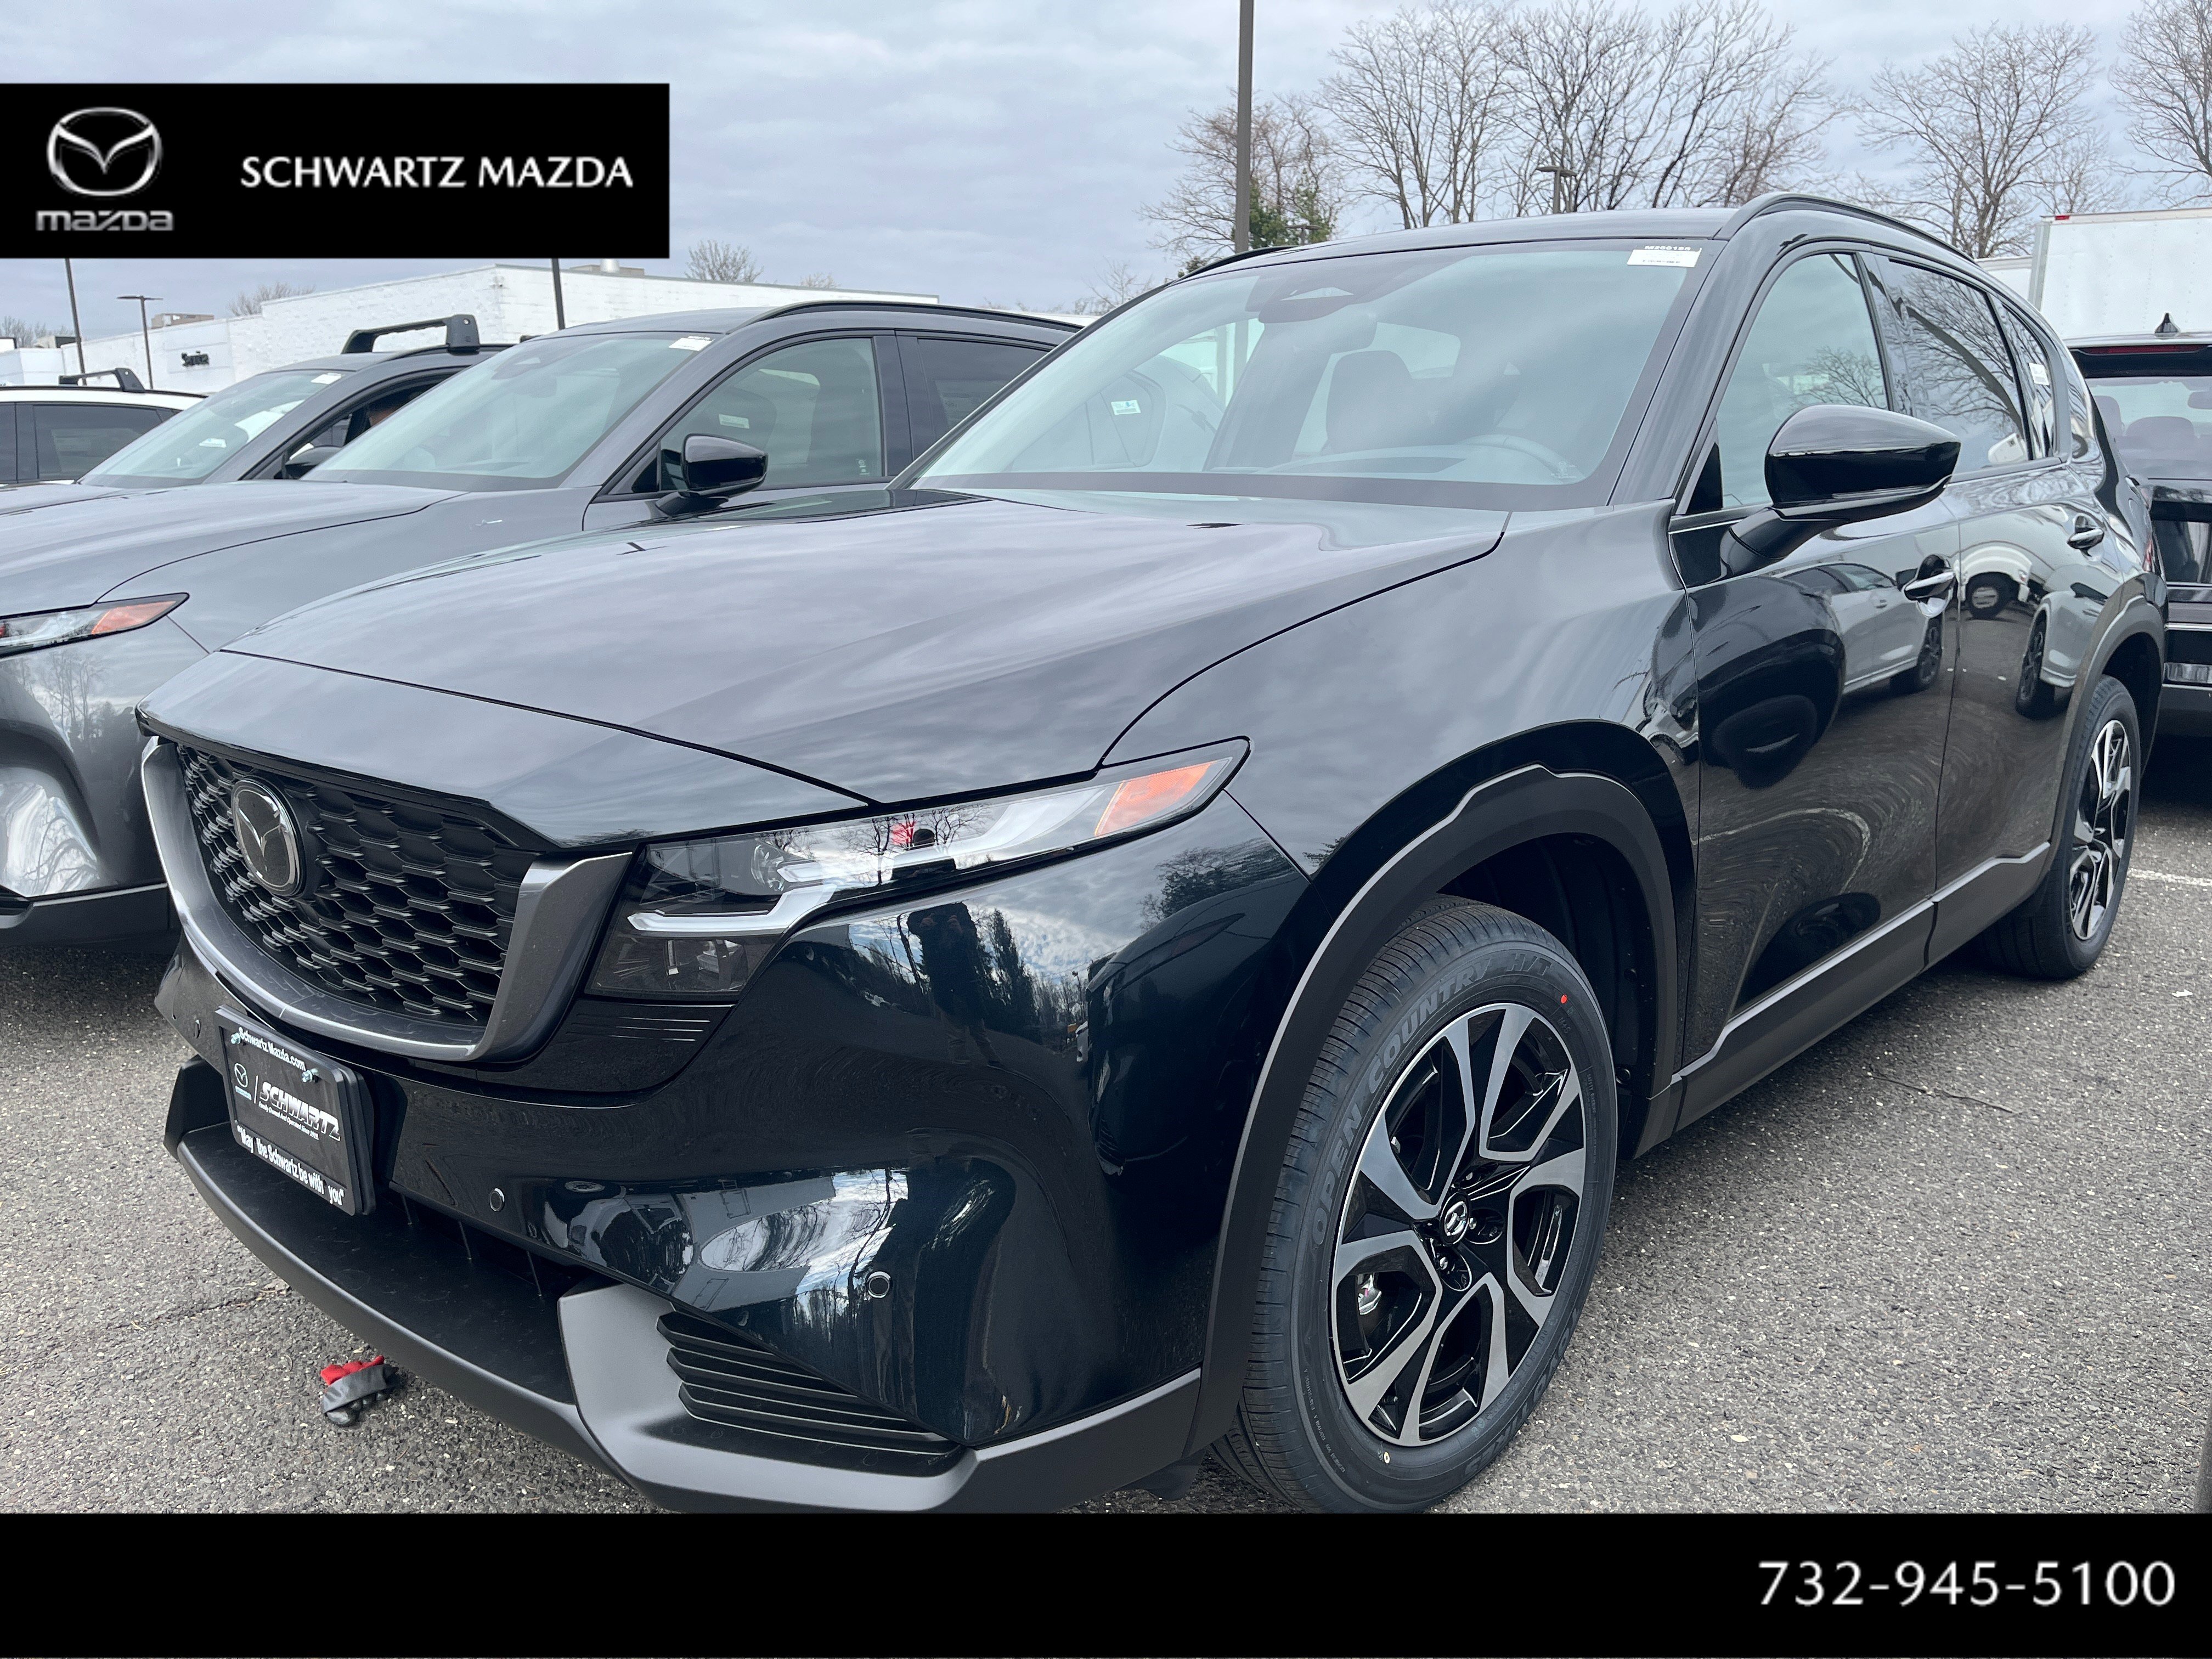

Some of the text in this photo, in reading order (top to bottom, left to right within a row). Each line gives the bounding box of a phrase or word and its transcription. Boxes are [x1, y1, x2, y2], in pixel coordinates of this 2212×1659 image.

[1557, 1017, 1571, 1034] M+S
[259, 1081, 341, 1141] SCHWARTZ
[1313, 1103, 1362, 1245] OPEN
[1368, 958, 1493, 1093] COUNTRY
[1505, 953, 1553, 976] H/T
[256, 1137, 268, 1159] the
[267, 1144, 299, 1179] Schwartz
[298, 1163, 308, 1184] be
[308, 1172, 324, 1195] with
[1464, 1401, 1531, 1480] TIRES
